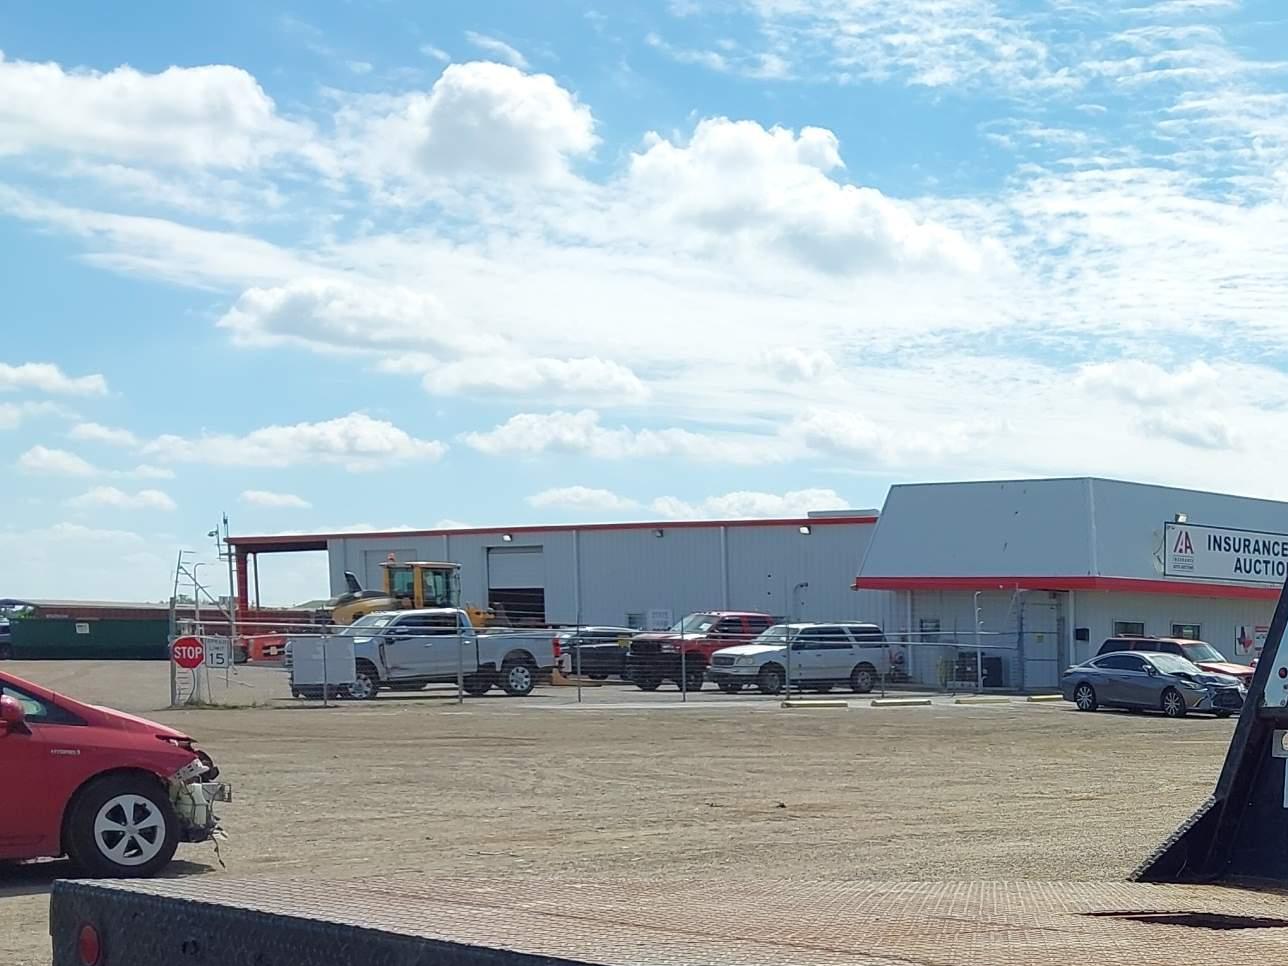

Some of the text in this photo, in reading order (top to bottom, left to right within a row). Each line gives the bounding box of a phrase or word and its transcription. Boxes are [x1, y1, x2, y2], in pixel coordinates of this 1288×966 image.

[1208, 534, 1288, 557] INSURANCE
[174, 646, 202, 659] STOP
[210, 653, 225, 664] 15
